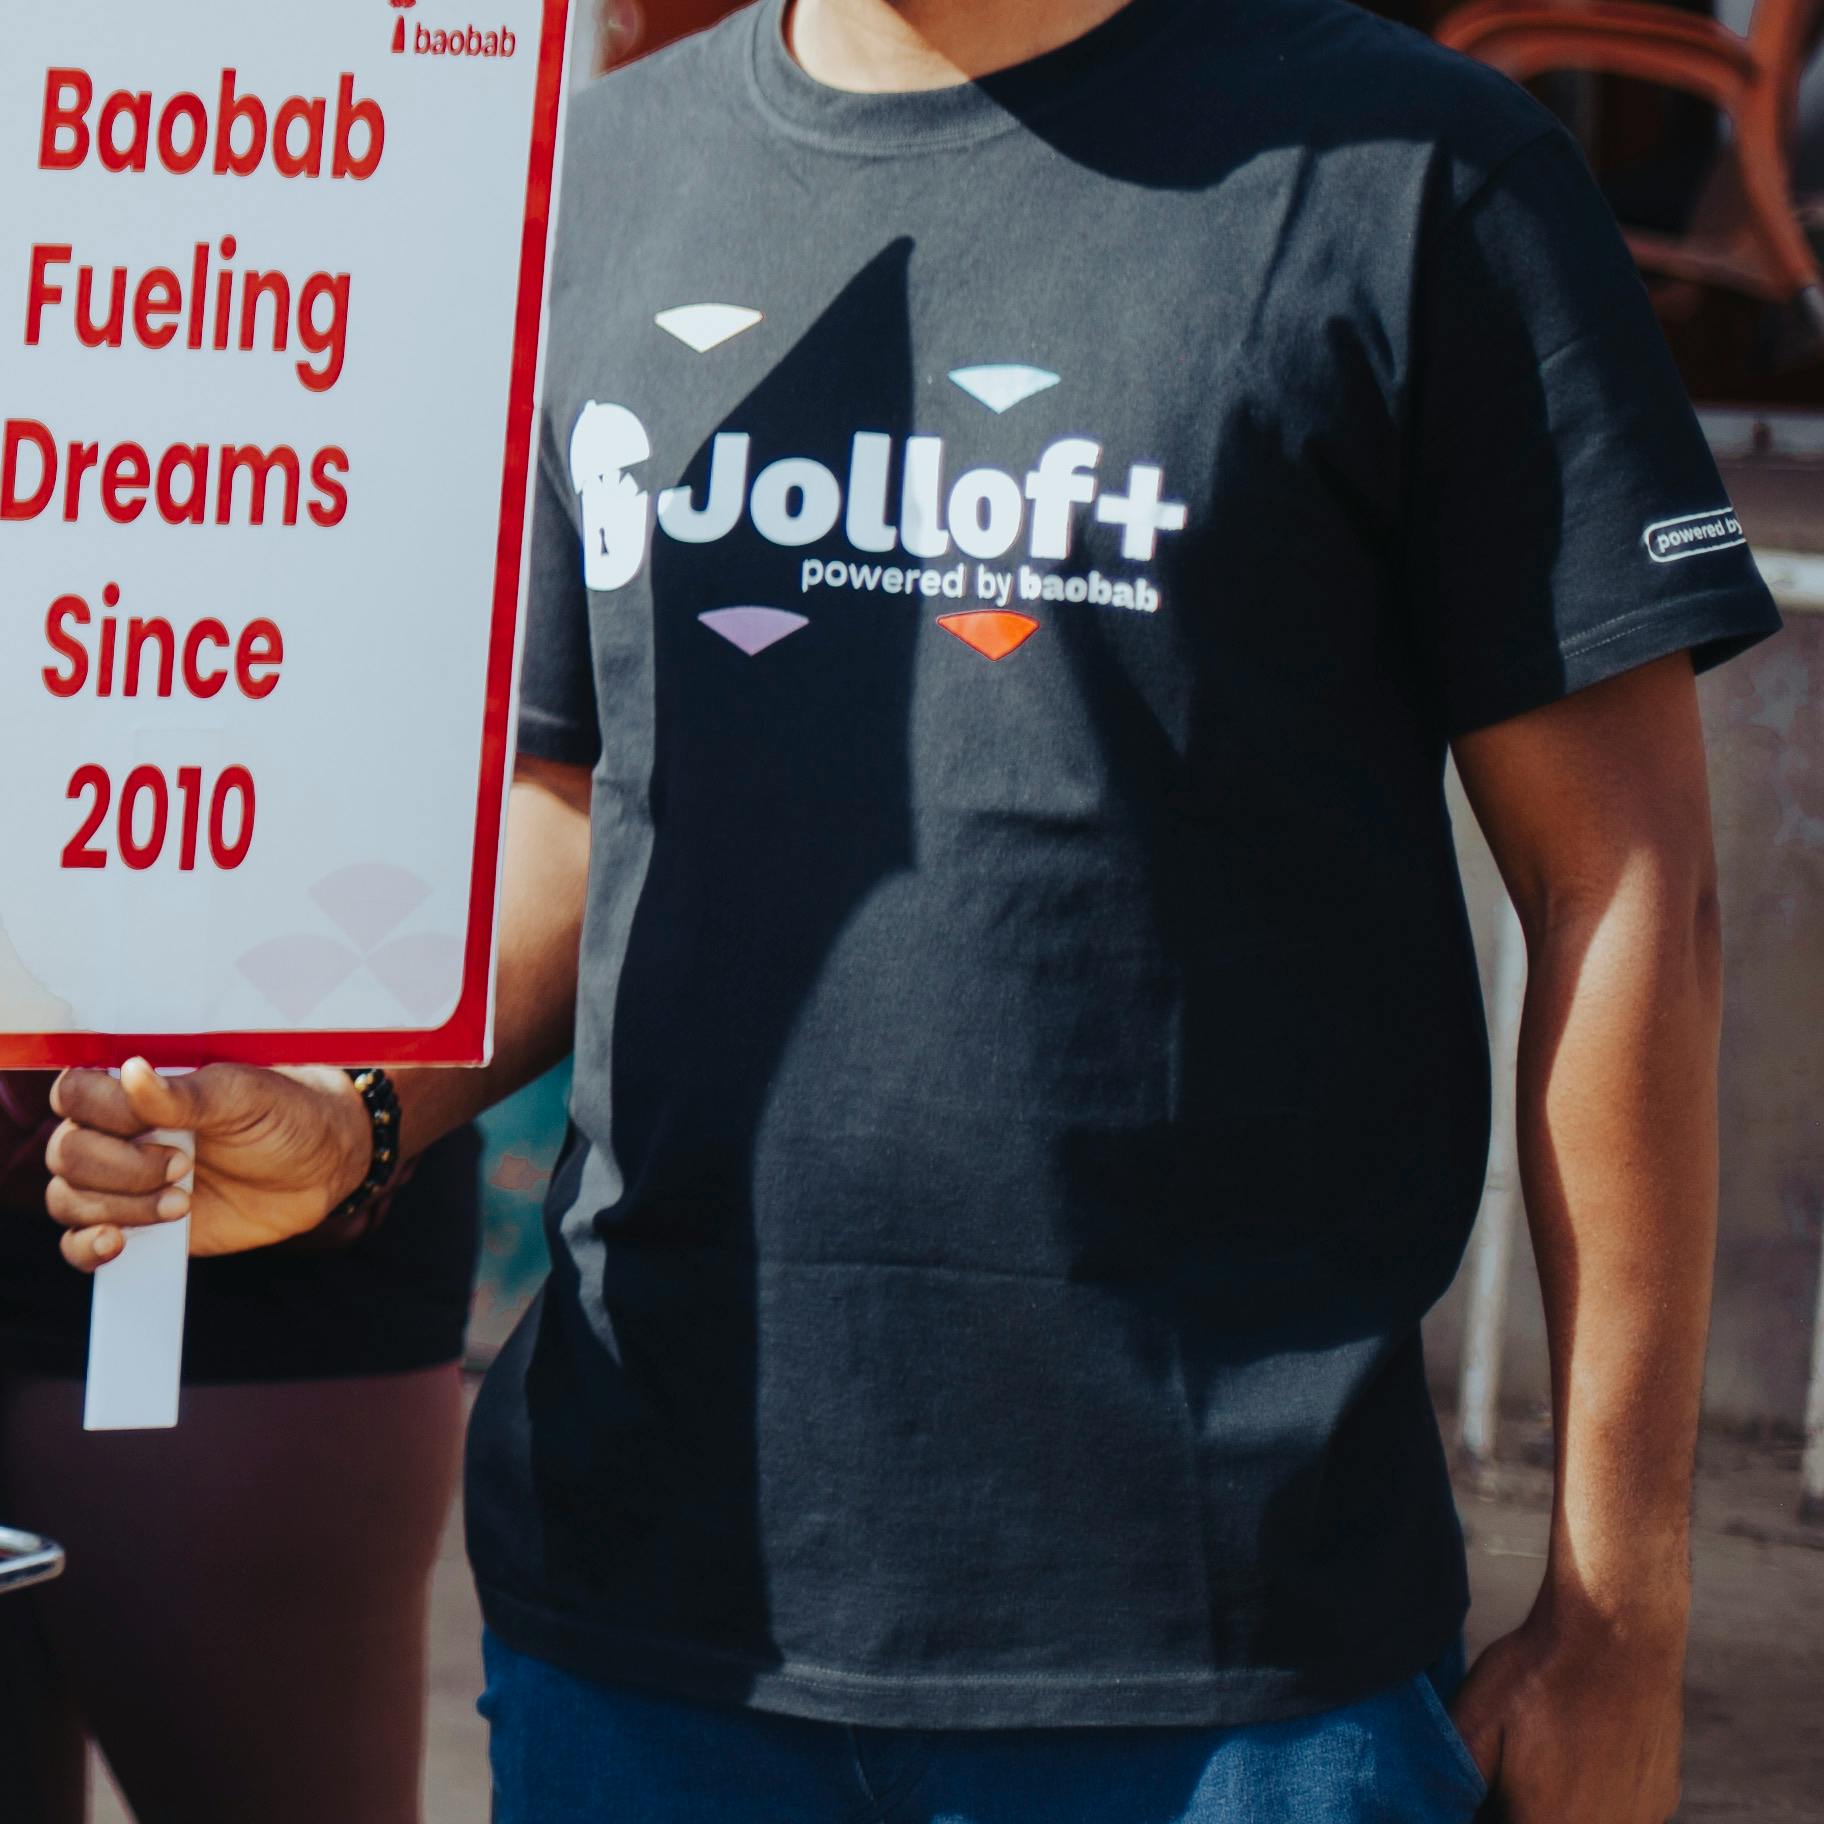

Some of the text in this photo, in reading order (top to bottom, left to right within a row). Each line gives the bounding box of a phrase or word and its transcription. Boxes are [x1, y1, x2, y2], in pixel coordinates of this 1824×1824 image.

[414, 22, 517, 58] baobab
[37, 67, 386, 181] Baobab
[24, 234, 352, 393] Fueling
[657, 430, 1188, 563] Jollof+
[1656, 519, 1726, 553] powered
[41, 581, 285, 701] Since
[801, 558, 1160, 613] powered by baobab
[60, 763, 257, 872] 2010
